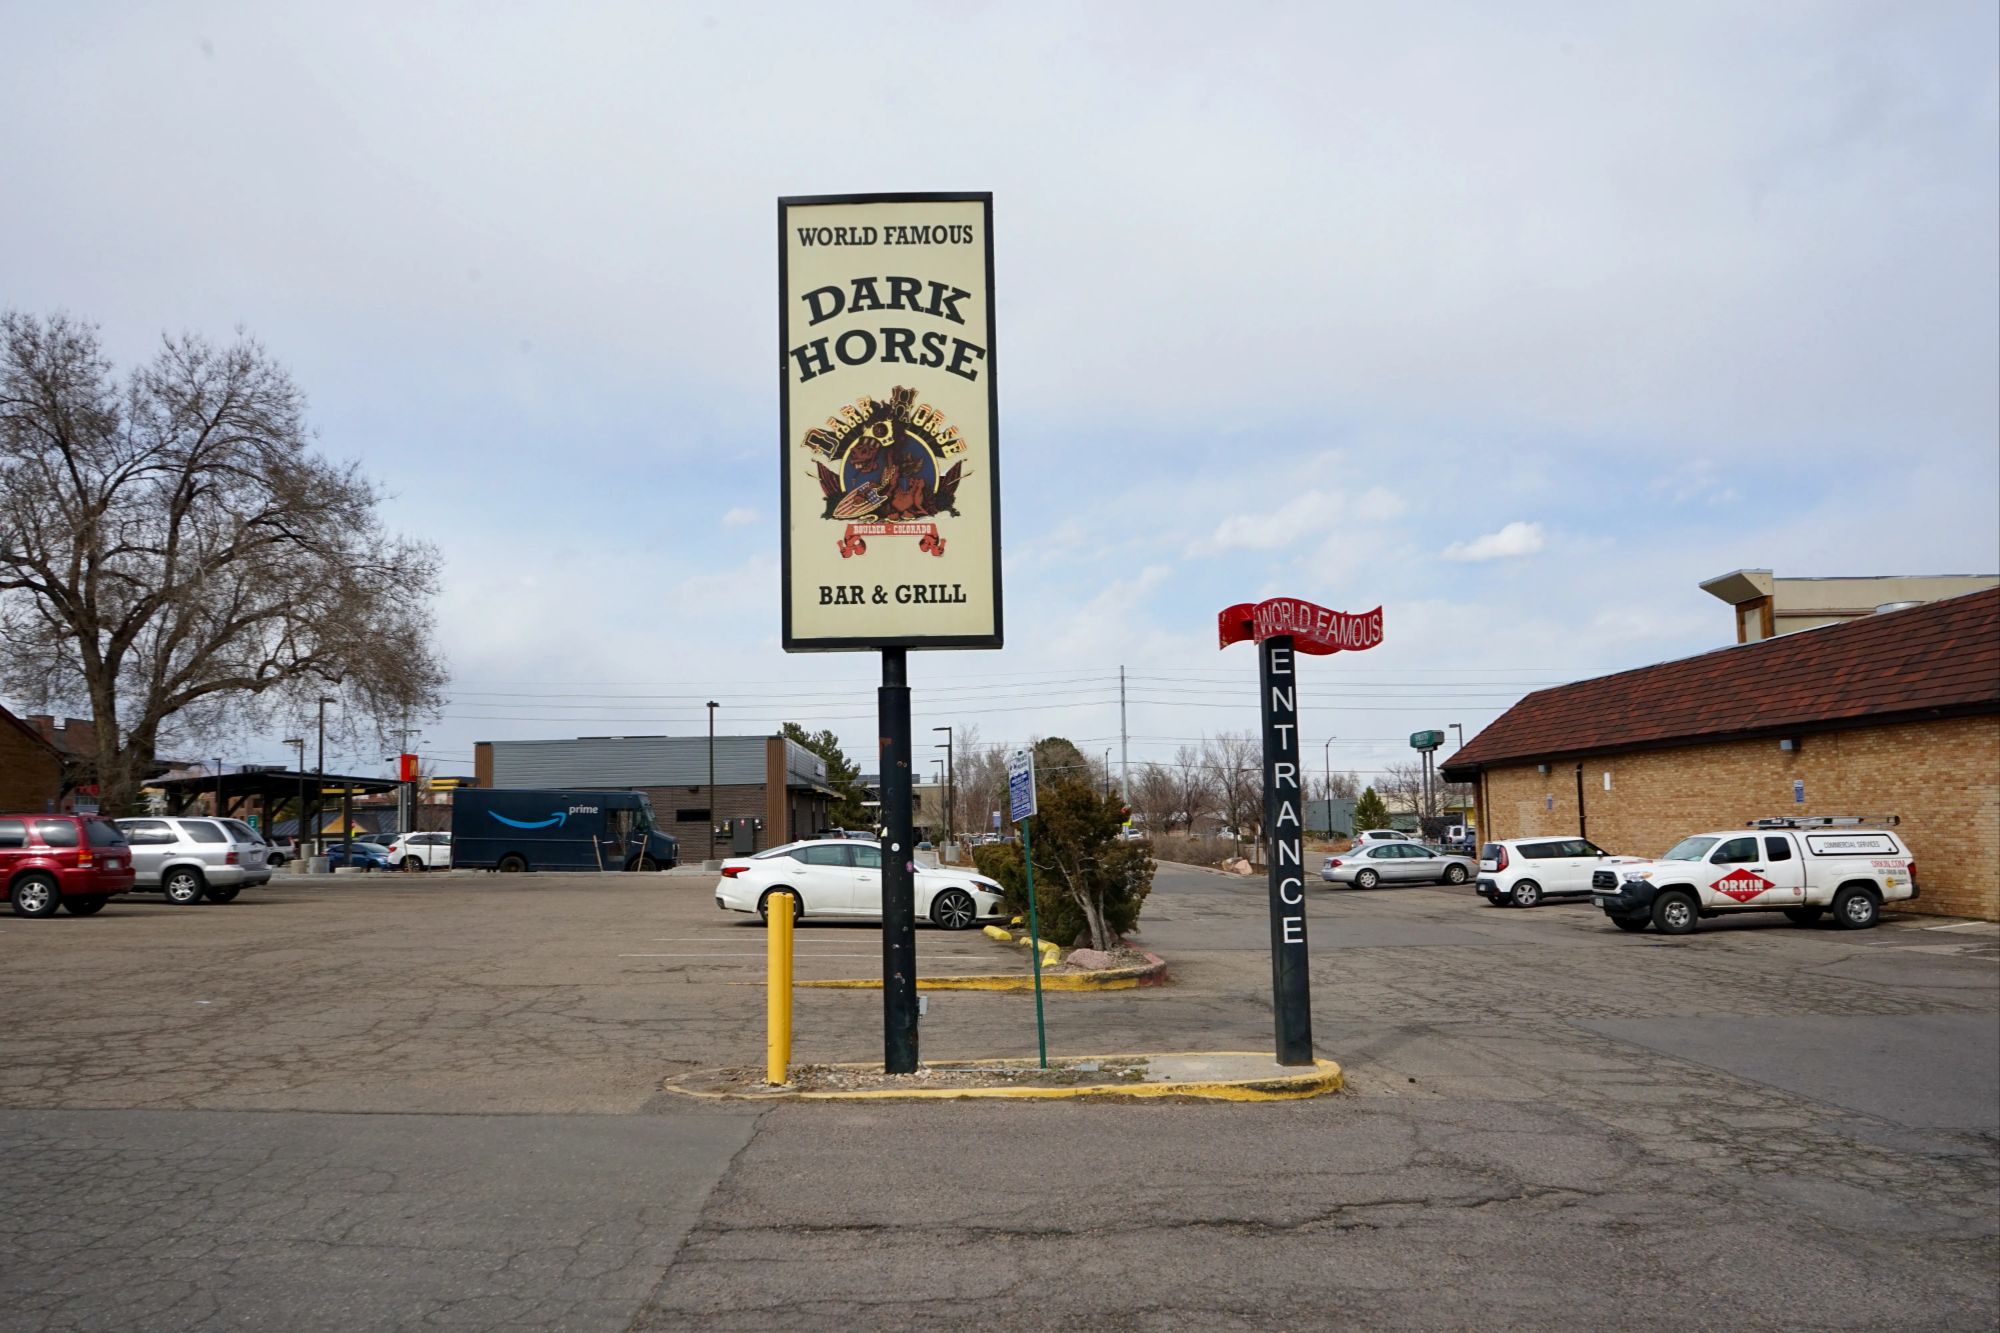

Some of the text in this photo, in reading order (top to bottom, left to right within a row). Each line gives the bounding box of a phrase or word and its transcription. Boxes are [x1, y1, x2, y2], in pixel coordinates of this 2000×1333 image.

[797, 225, 973, 246] WORLD FAMOUS
[801, 276, 971, 326] DARK
[790, 328, 986, 383] HORSE
[853, 524, 932, 534] BOULDER COLORADO
[819, 584, 967, 605] BAR & GRILL
[1257, 602, 1380, 647] WORLD FAMOUS
[1271, 648, 1304, 944] ENTRANCE
[568, 804, 598, 816] prime
[1718, 879, 1764, 892] ORKIN
